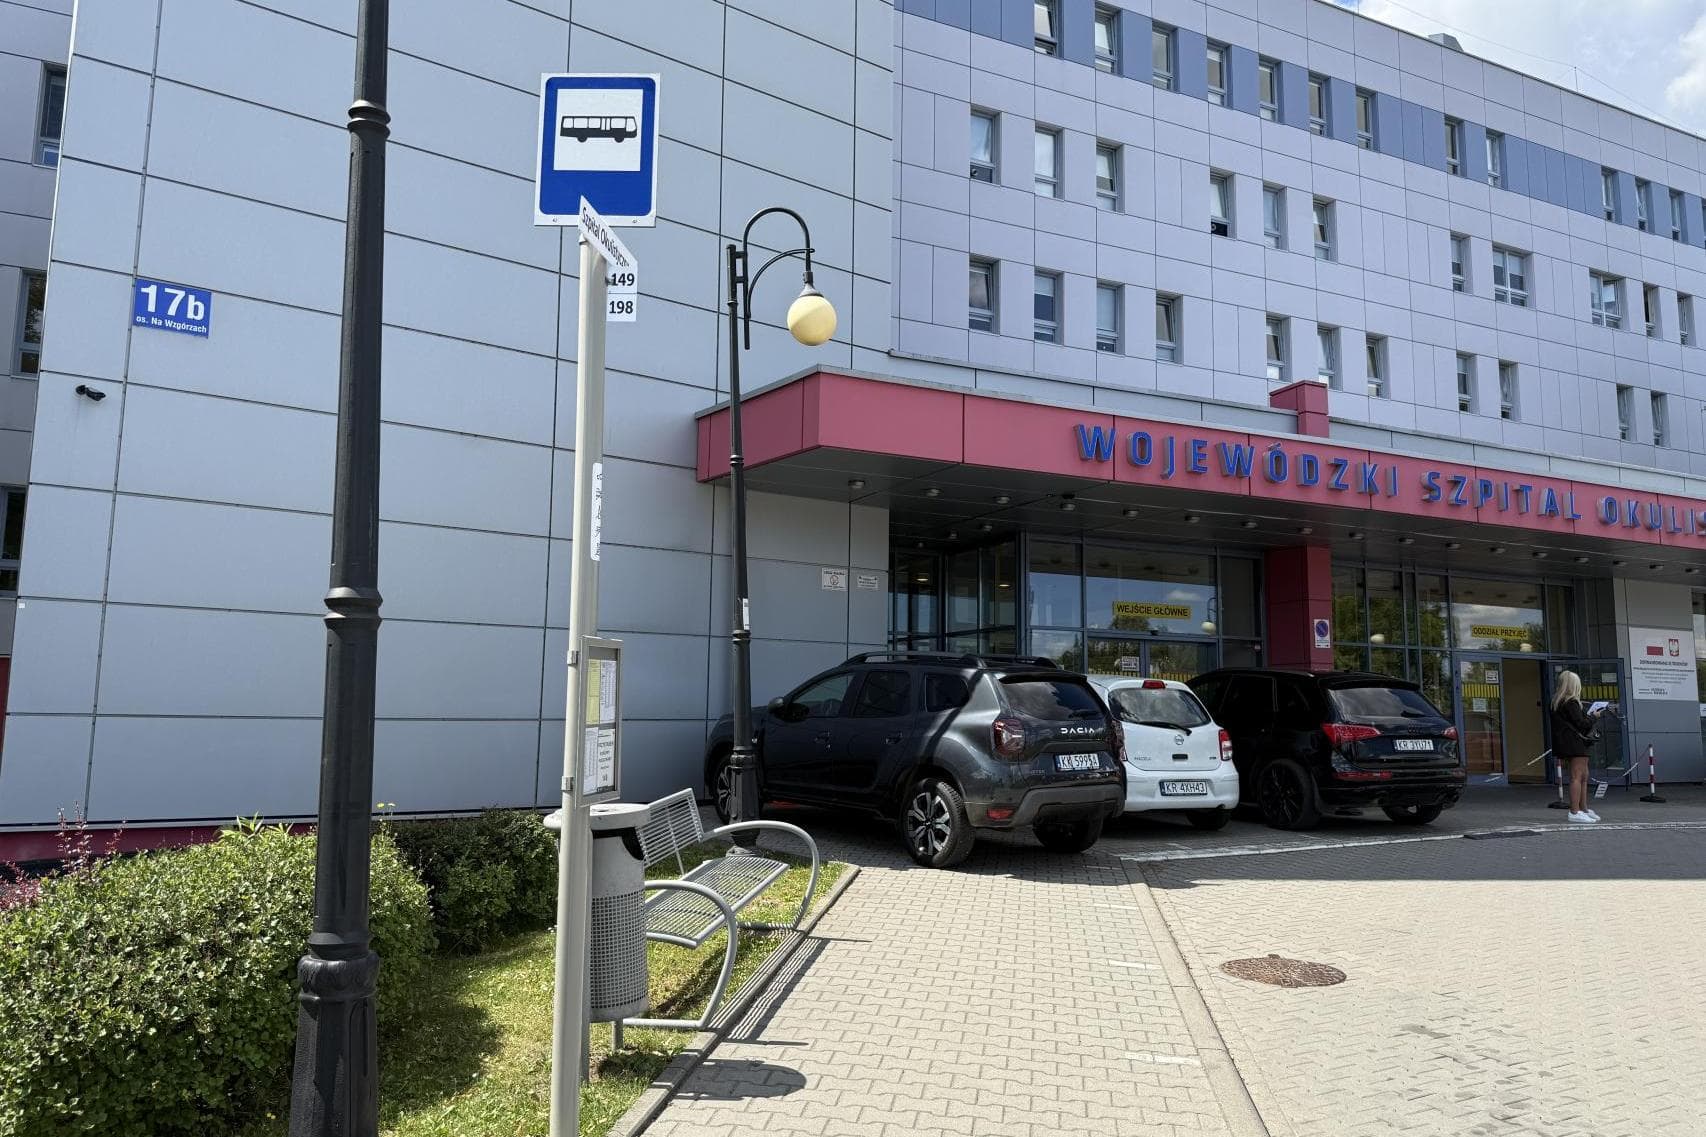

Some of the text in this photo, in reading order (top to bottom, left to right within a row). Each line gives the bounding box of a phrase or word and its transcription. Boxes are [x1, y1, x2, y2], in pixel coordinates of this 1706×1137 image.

[582, 206, 601, 239] Szpital
[611, 273, 635, 286] 149
[140, 284, 205, 321] 17b
[609, 301, 634, 314] 198
[151, 317, 163, 326] Na
[165, 319, 207, 333] Wzgórzach
[1075, 423, 1399, 497] WOJEWÓDZKI
[1420, 471, 1582, 521] SZPITAL
[1117, 603, 1188, 616] WEJŚCIE GŁÓWNE
[1473, 627, 1499, 636] ODDZIAŁ
[1165, 782, 1206, 793] KR 4XH43
